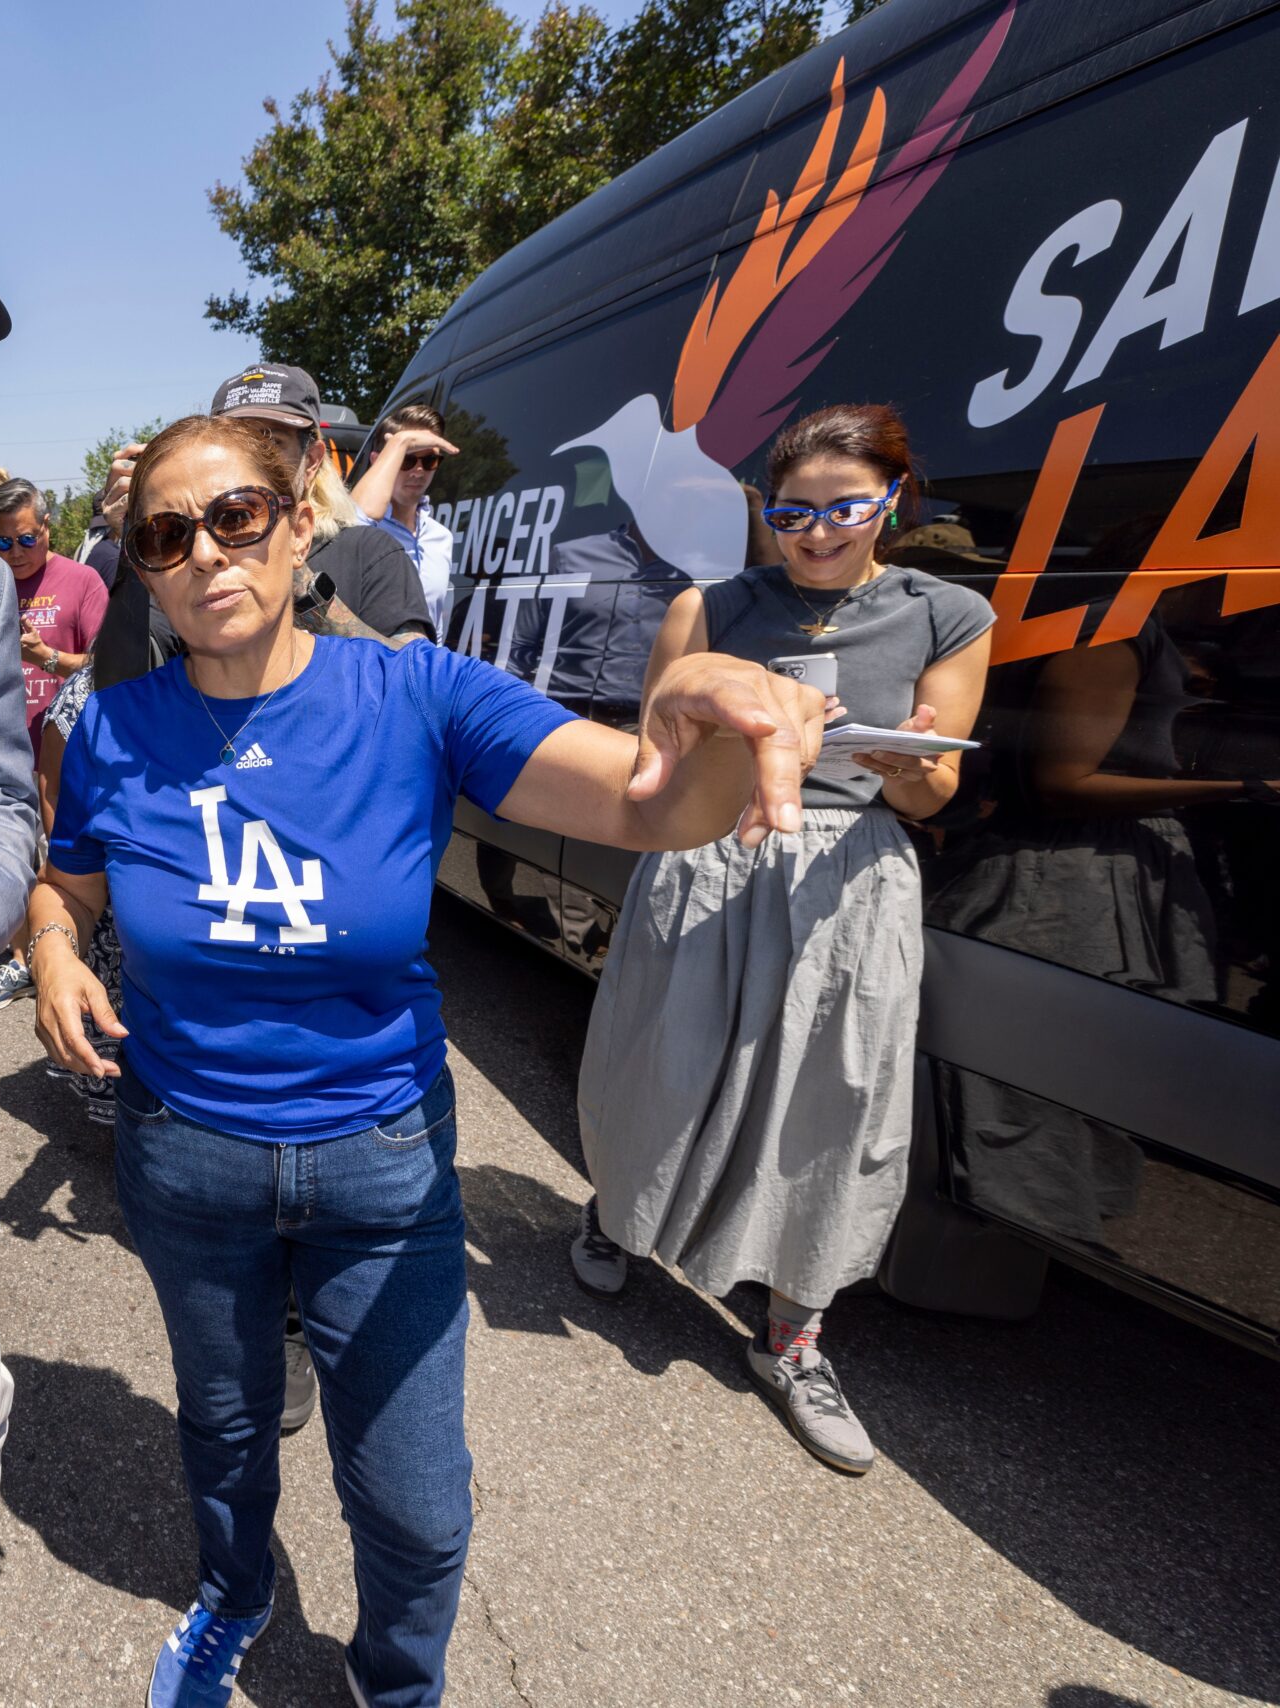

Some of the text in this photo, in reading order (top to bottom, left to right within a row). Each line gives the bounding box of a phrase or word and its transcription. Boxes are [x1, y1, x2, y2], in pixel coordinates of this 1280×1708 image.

[967, 117, 1280, 428] SA
[429, 485, 565, 575] PENCER
[20, 595, 56, 608] PARTY
[236, 757, 273, 770] adidas
[190, 785, 327, 943] LA
